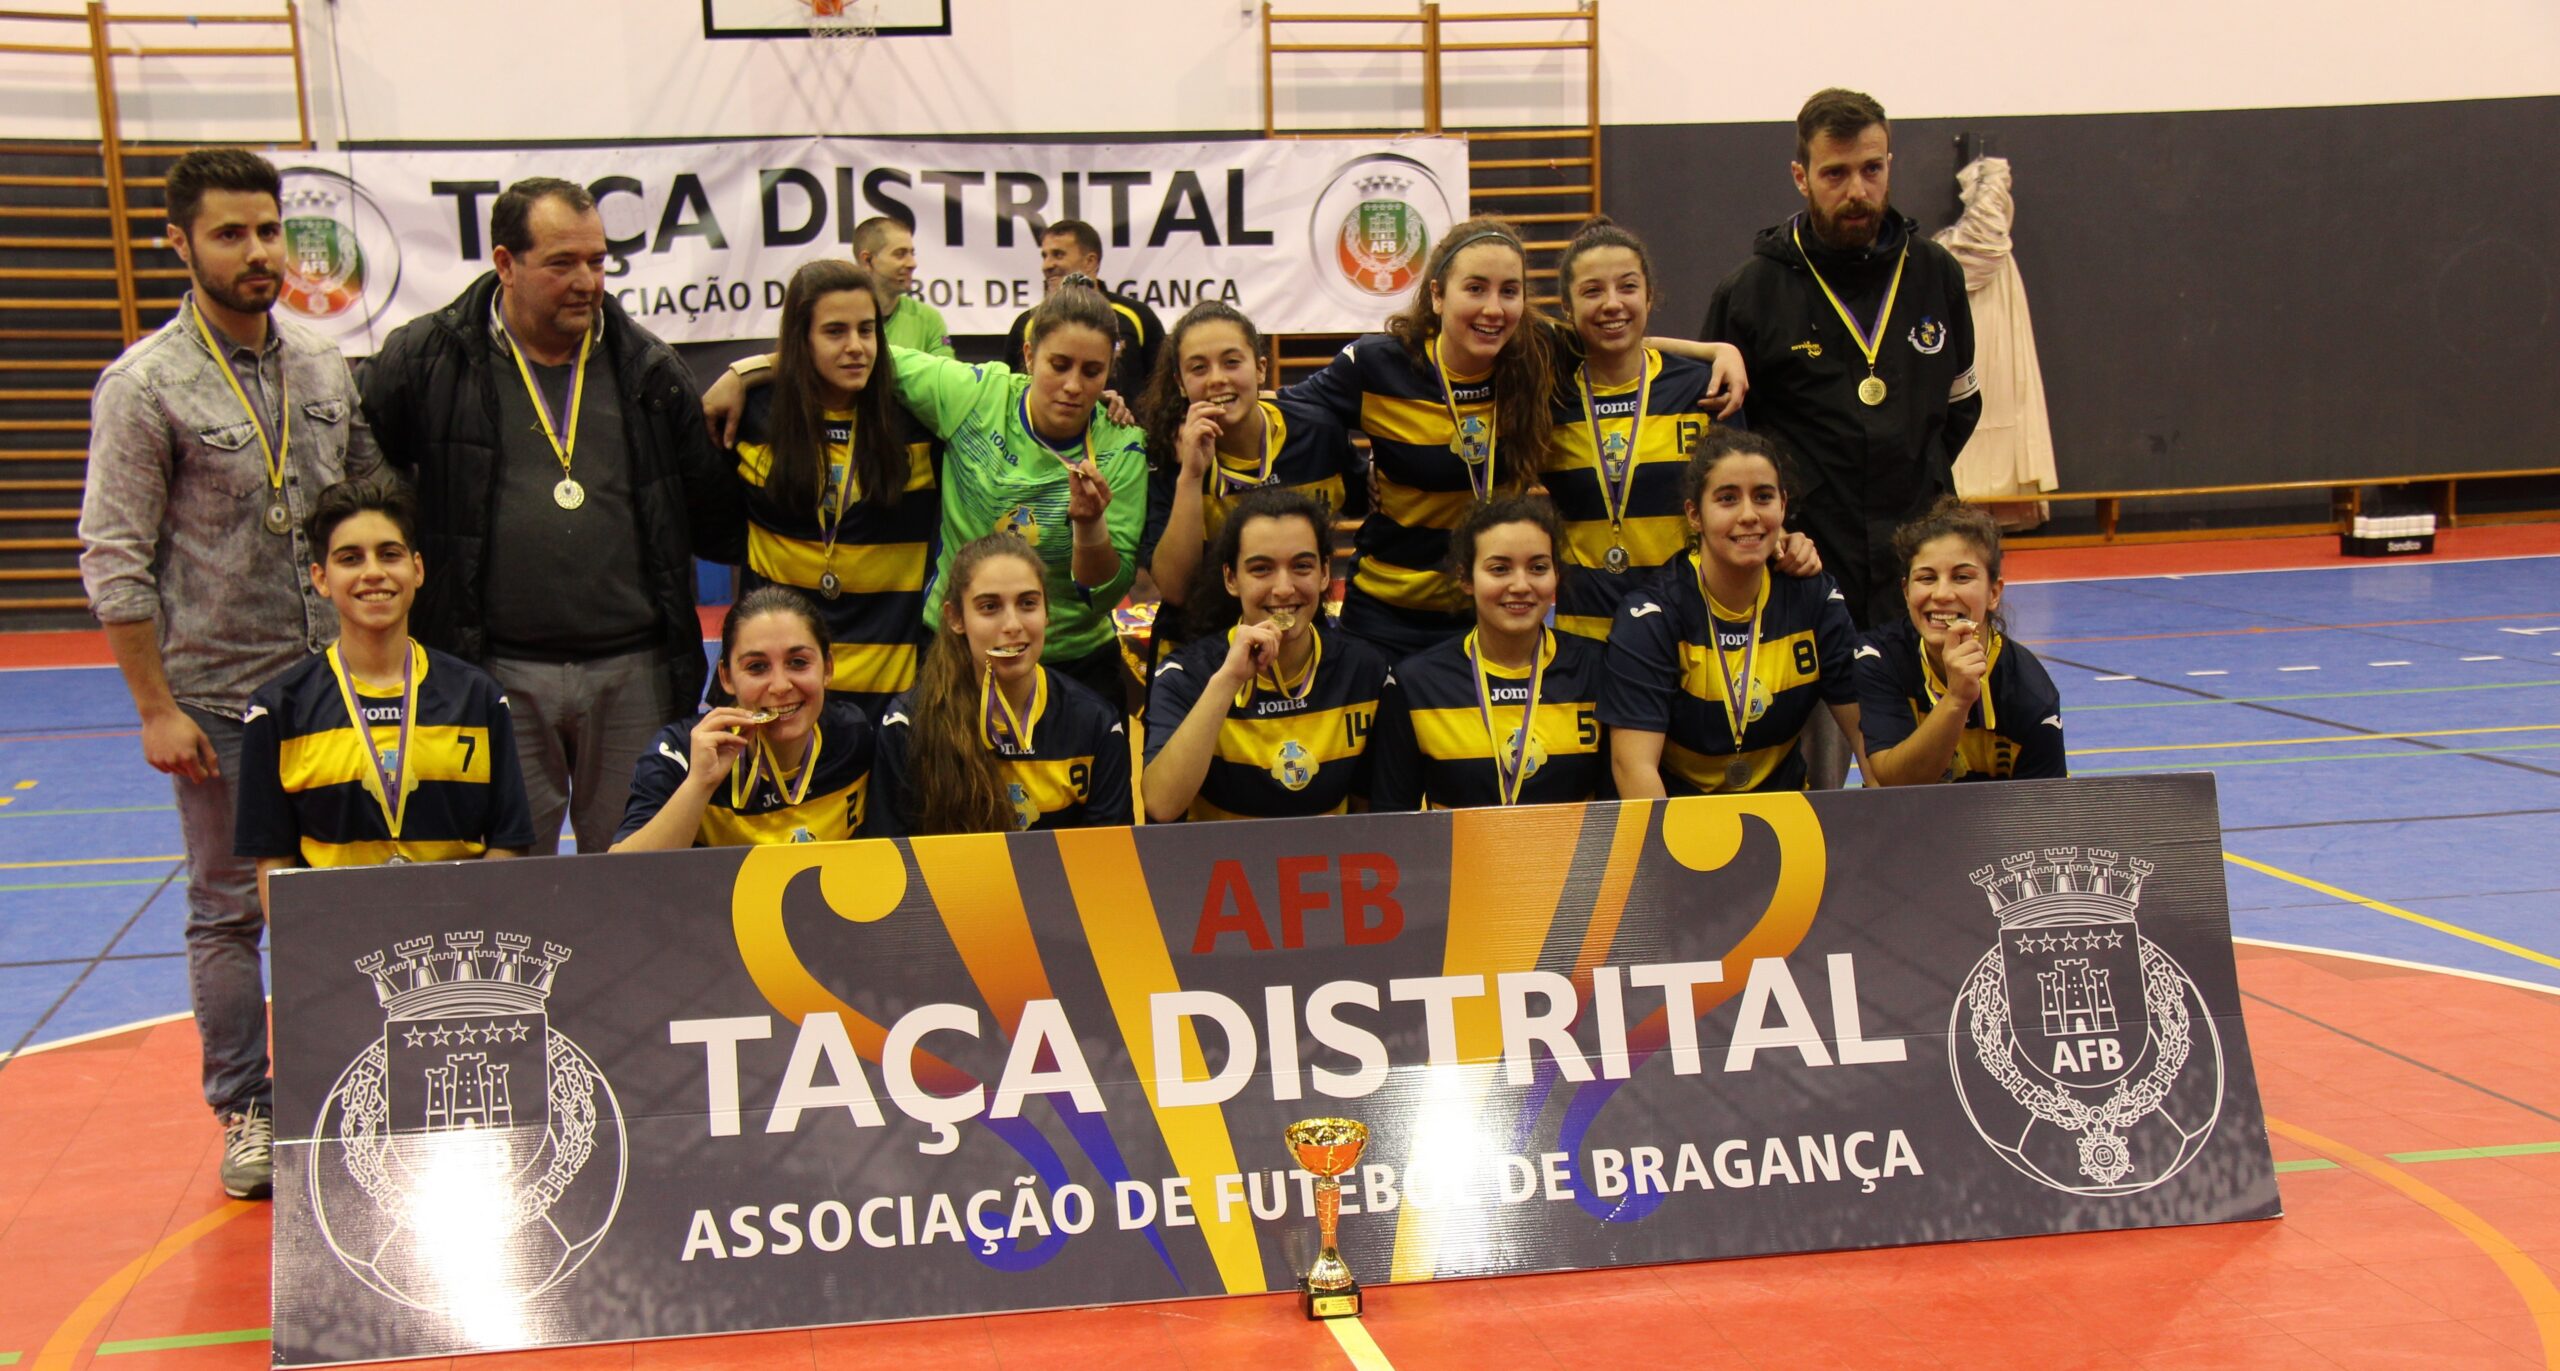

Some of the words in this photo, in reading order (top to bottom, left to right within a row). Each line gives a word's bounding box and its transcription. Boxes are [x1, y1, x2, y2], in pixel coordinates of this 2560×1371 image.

[431, 173, 729, 277] TÇA
[759, 166, 1275, 249] DISTRITAL
[1370, 240, 1397, 254] AFB
[301, 260, 330, 275] AFB
[616, 277, 751, 323] CIAÇÃO
[763, 280, 786, 310] D
[985, 279, 1030, 308] DE
[1676, 421, 1702, 455] 13
[1792, 639, 1818, 676] 8
[1491, 686, 1543, 702] Jom
[1344, 711, 1372, 748] 14
[1577, 710, 1598, 746] 5
[457, 734, 476, 774] 7
[1068, 763, 1089, 798] 9
[1191, 852, 1406, 955] AFB
[669, 998, 1108, 1156] TAÇA
[1149, 952, 1908, 1109] DISTRITAL
[2052, 1037, 2124, 1074] AFB
[680, 1175, 1096, 1262] ASSOCIAÇÃO
[1115, 1176, 1196, 1231] DE
[1497, 1151, 1576, 1205] DE
[1591, 1128, 1924, 1199] BRAGANÇA
